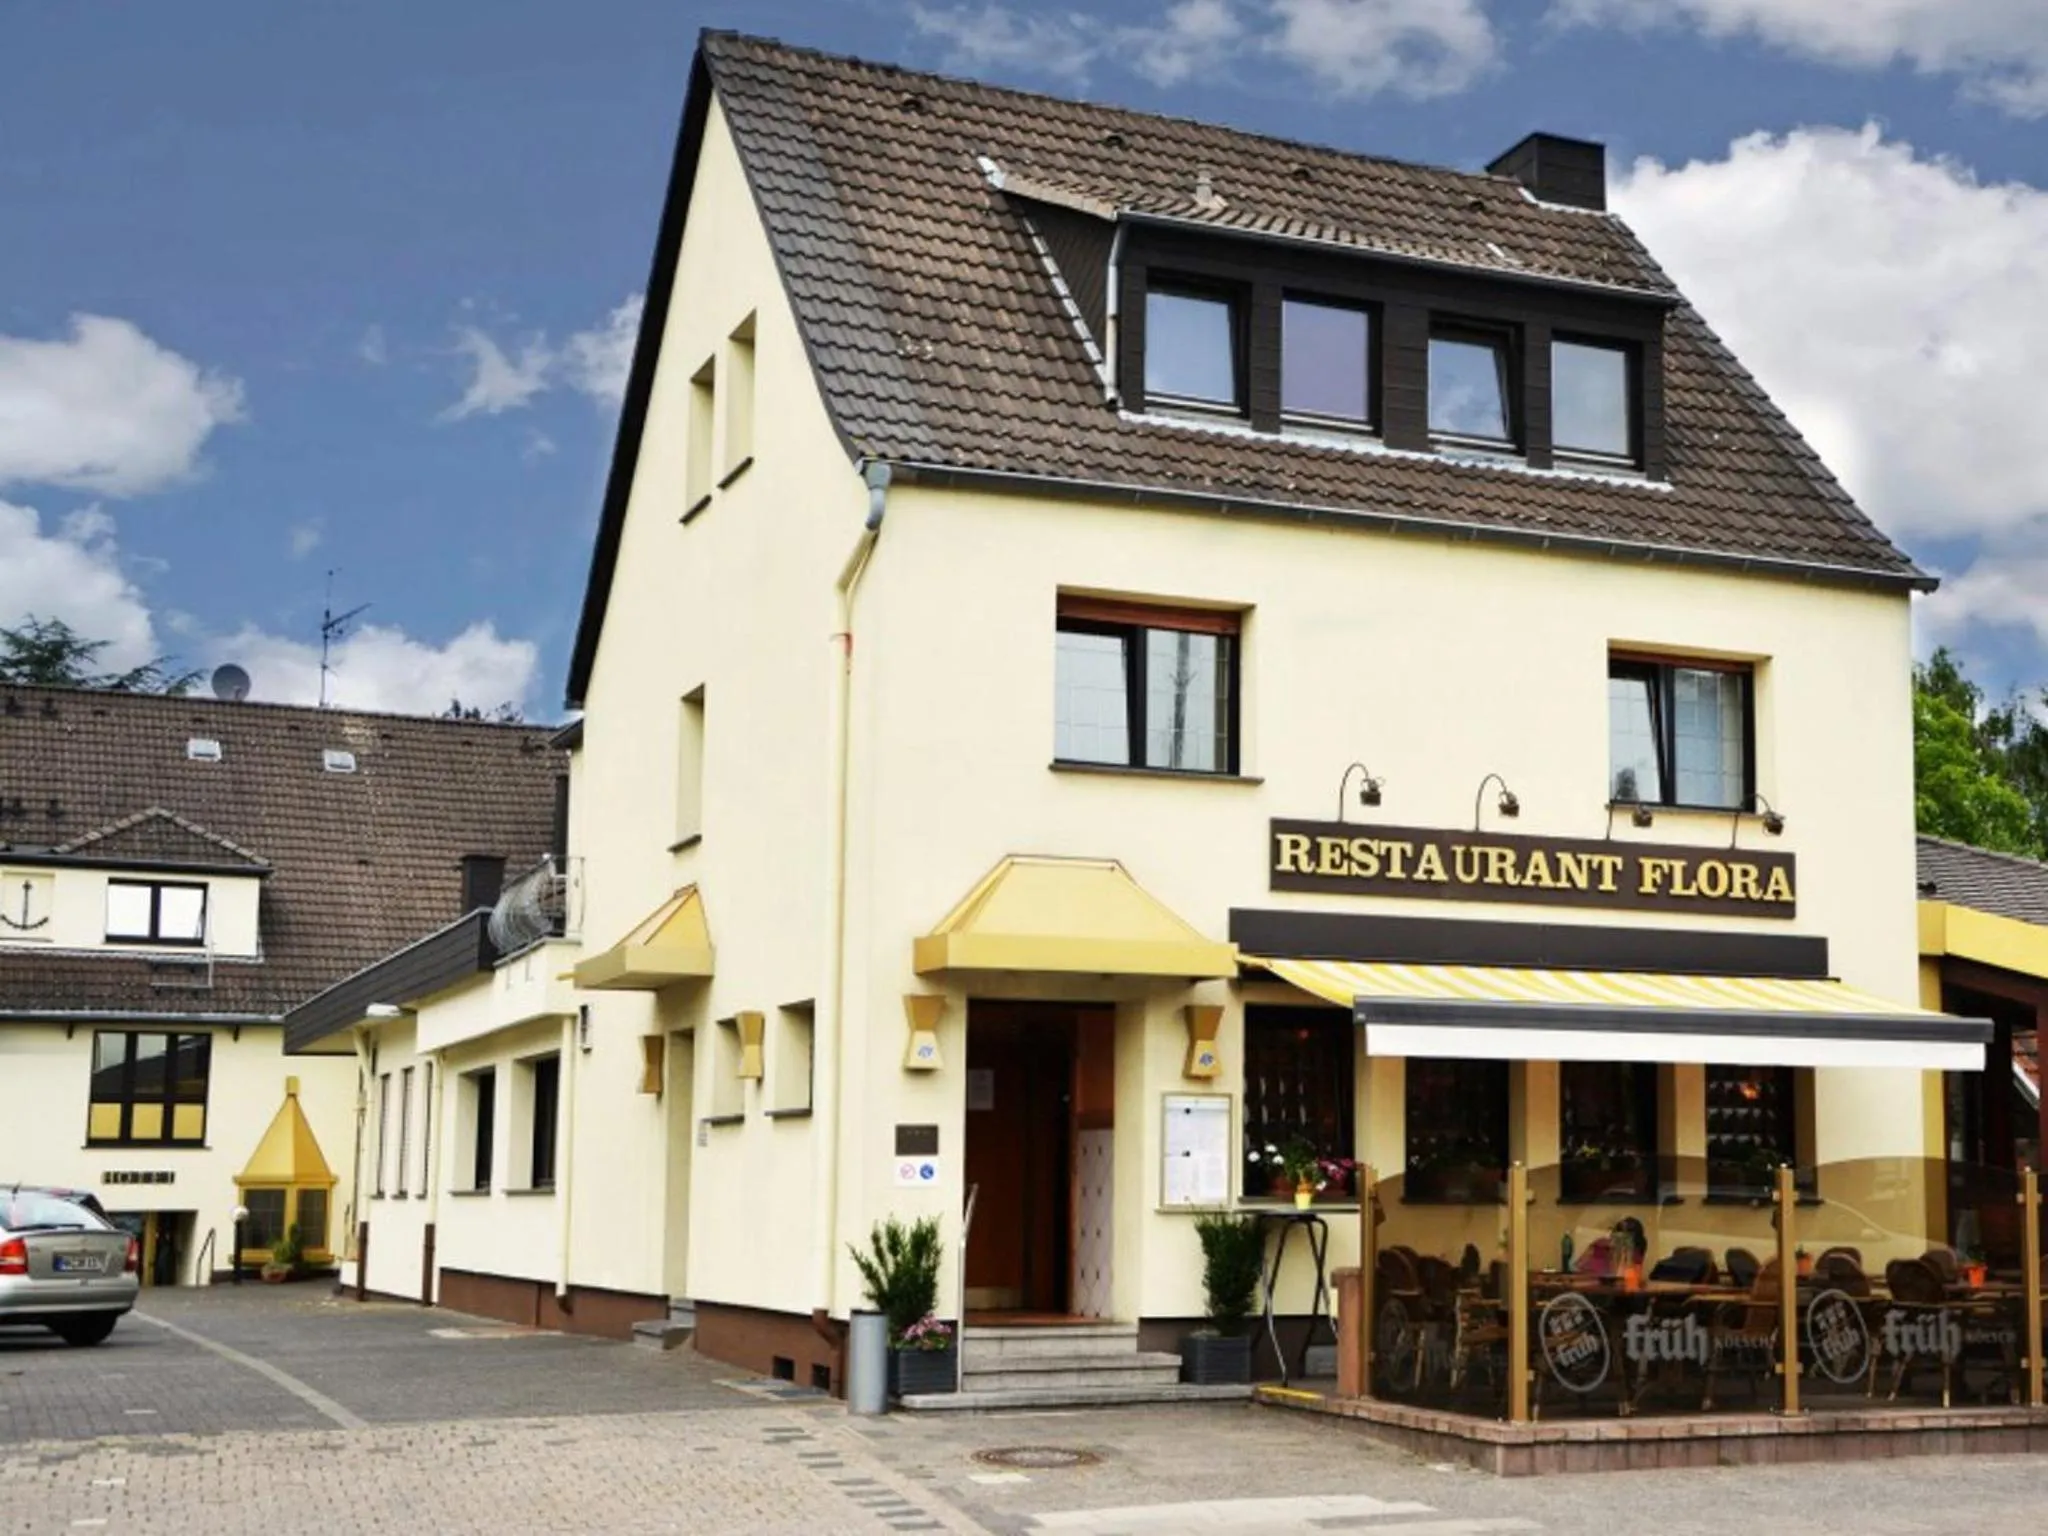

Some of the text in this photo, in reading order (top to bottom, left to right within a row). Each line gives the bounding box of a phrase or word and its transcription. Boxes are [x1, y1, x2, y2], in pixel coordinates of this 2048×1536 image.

[1275, 833, 1795, 902] RESTAURANT FLORA
[1624, 1314, 1708, 1364] früh
[1883, 1310, 1962, 1360] früh
